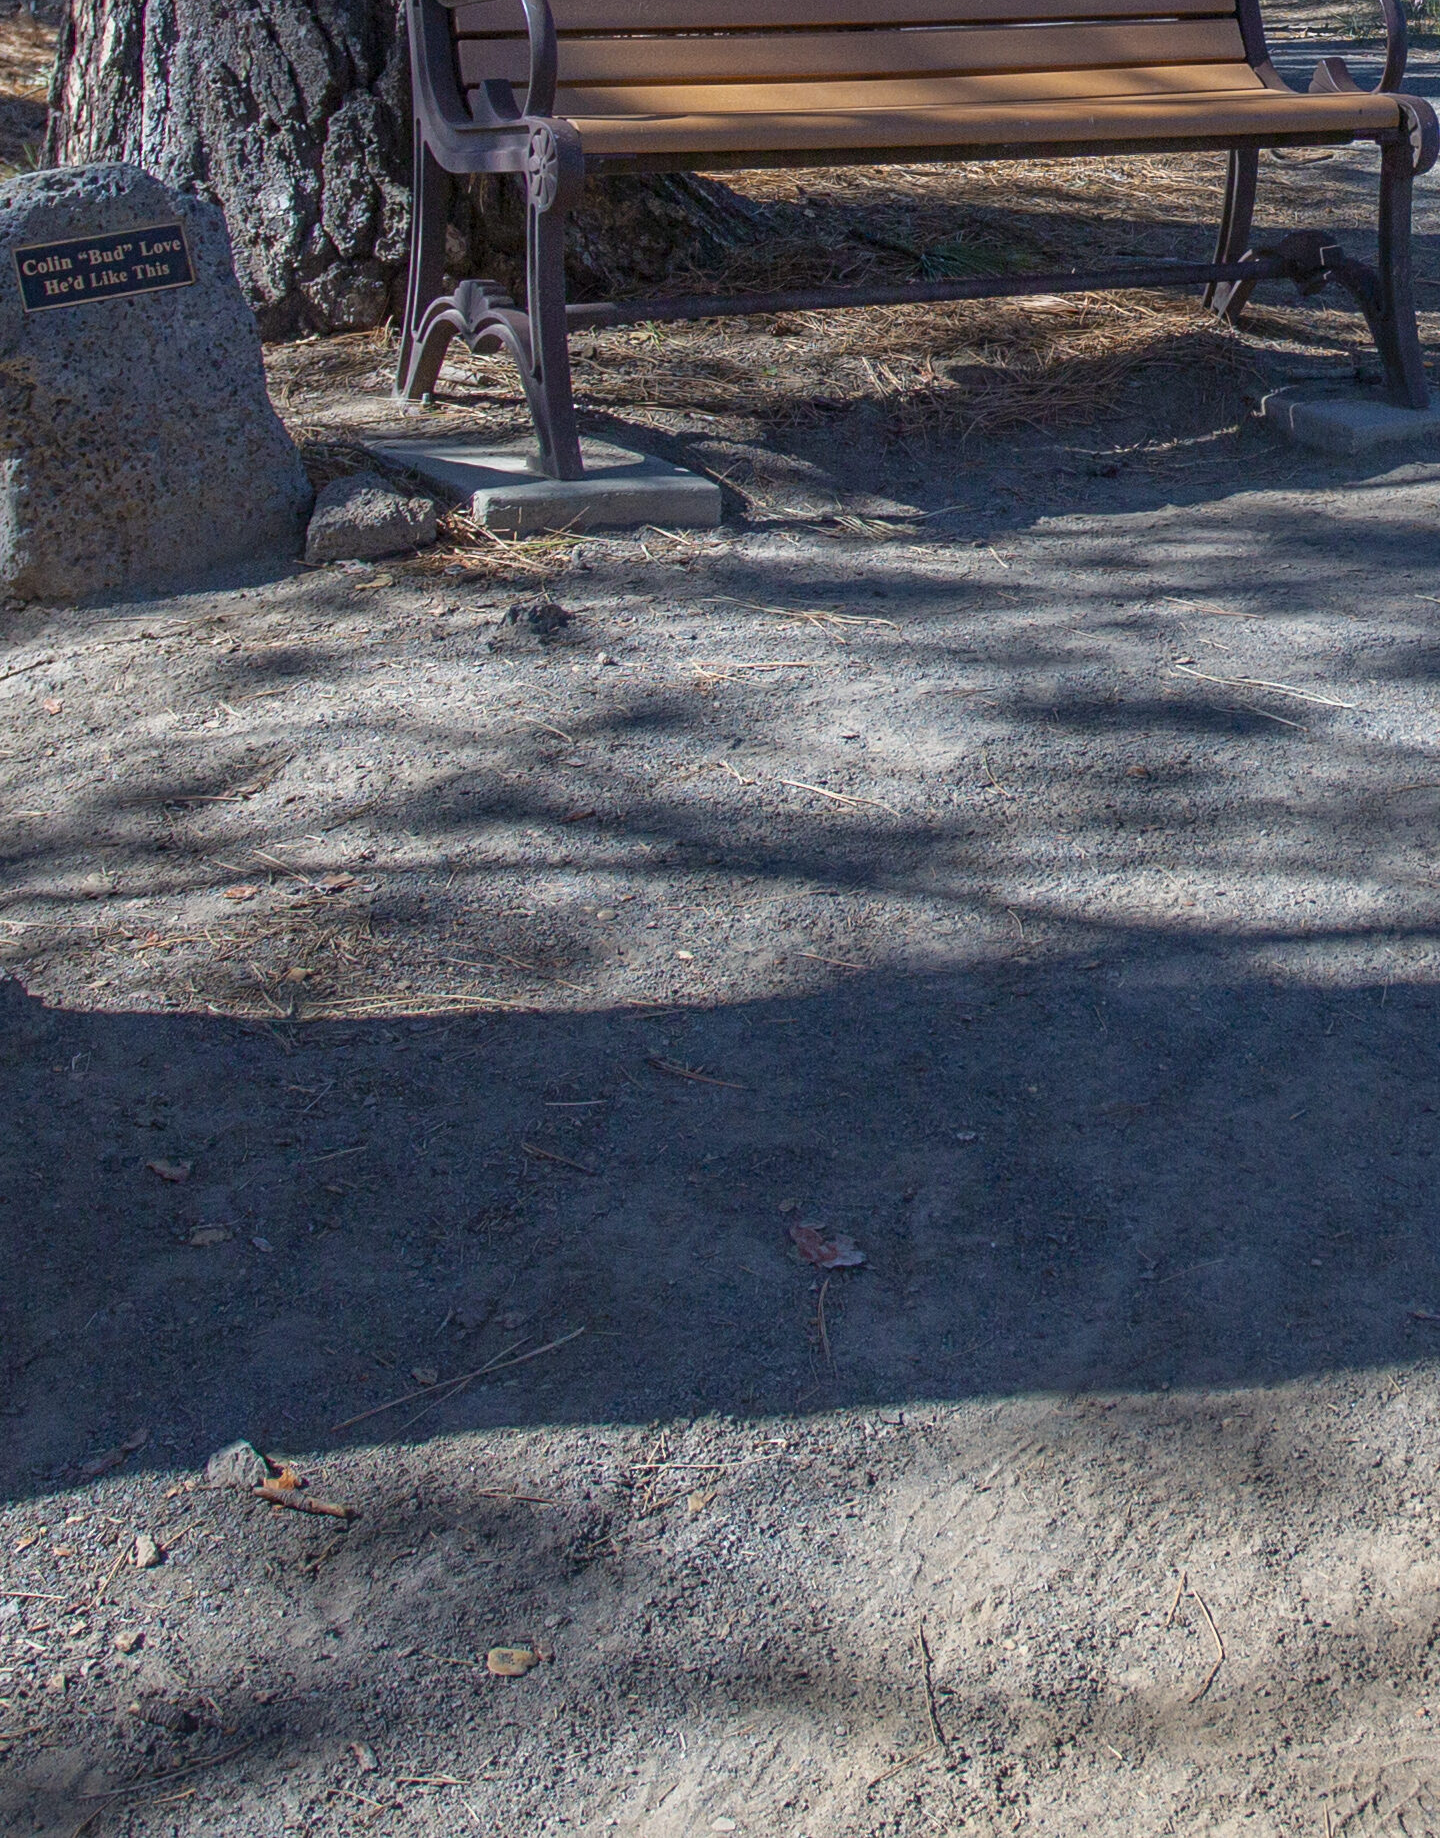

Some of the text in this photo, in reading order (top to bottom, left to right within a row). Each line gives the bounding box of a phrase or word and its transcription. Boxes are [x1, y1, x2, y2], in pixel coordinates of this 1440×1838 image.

[22, 256, 73, 276] Colin
[139, 238, 181, 257] Love
[90, 269, 128, 288] Like
[132, 261, 170, 280] This
